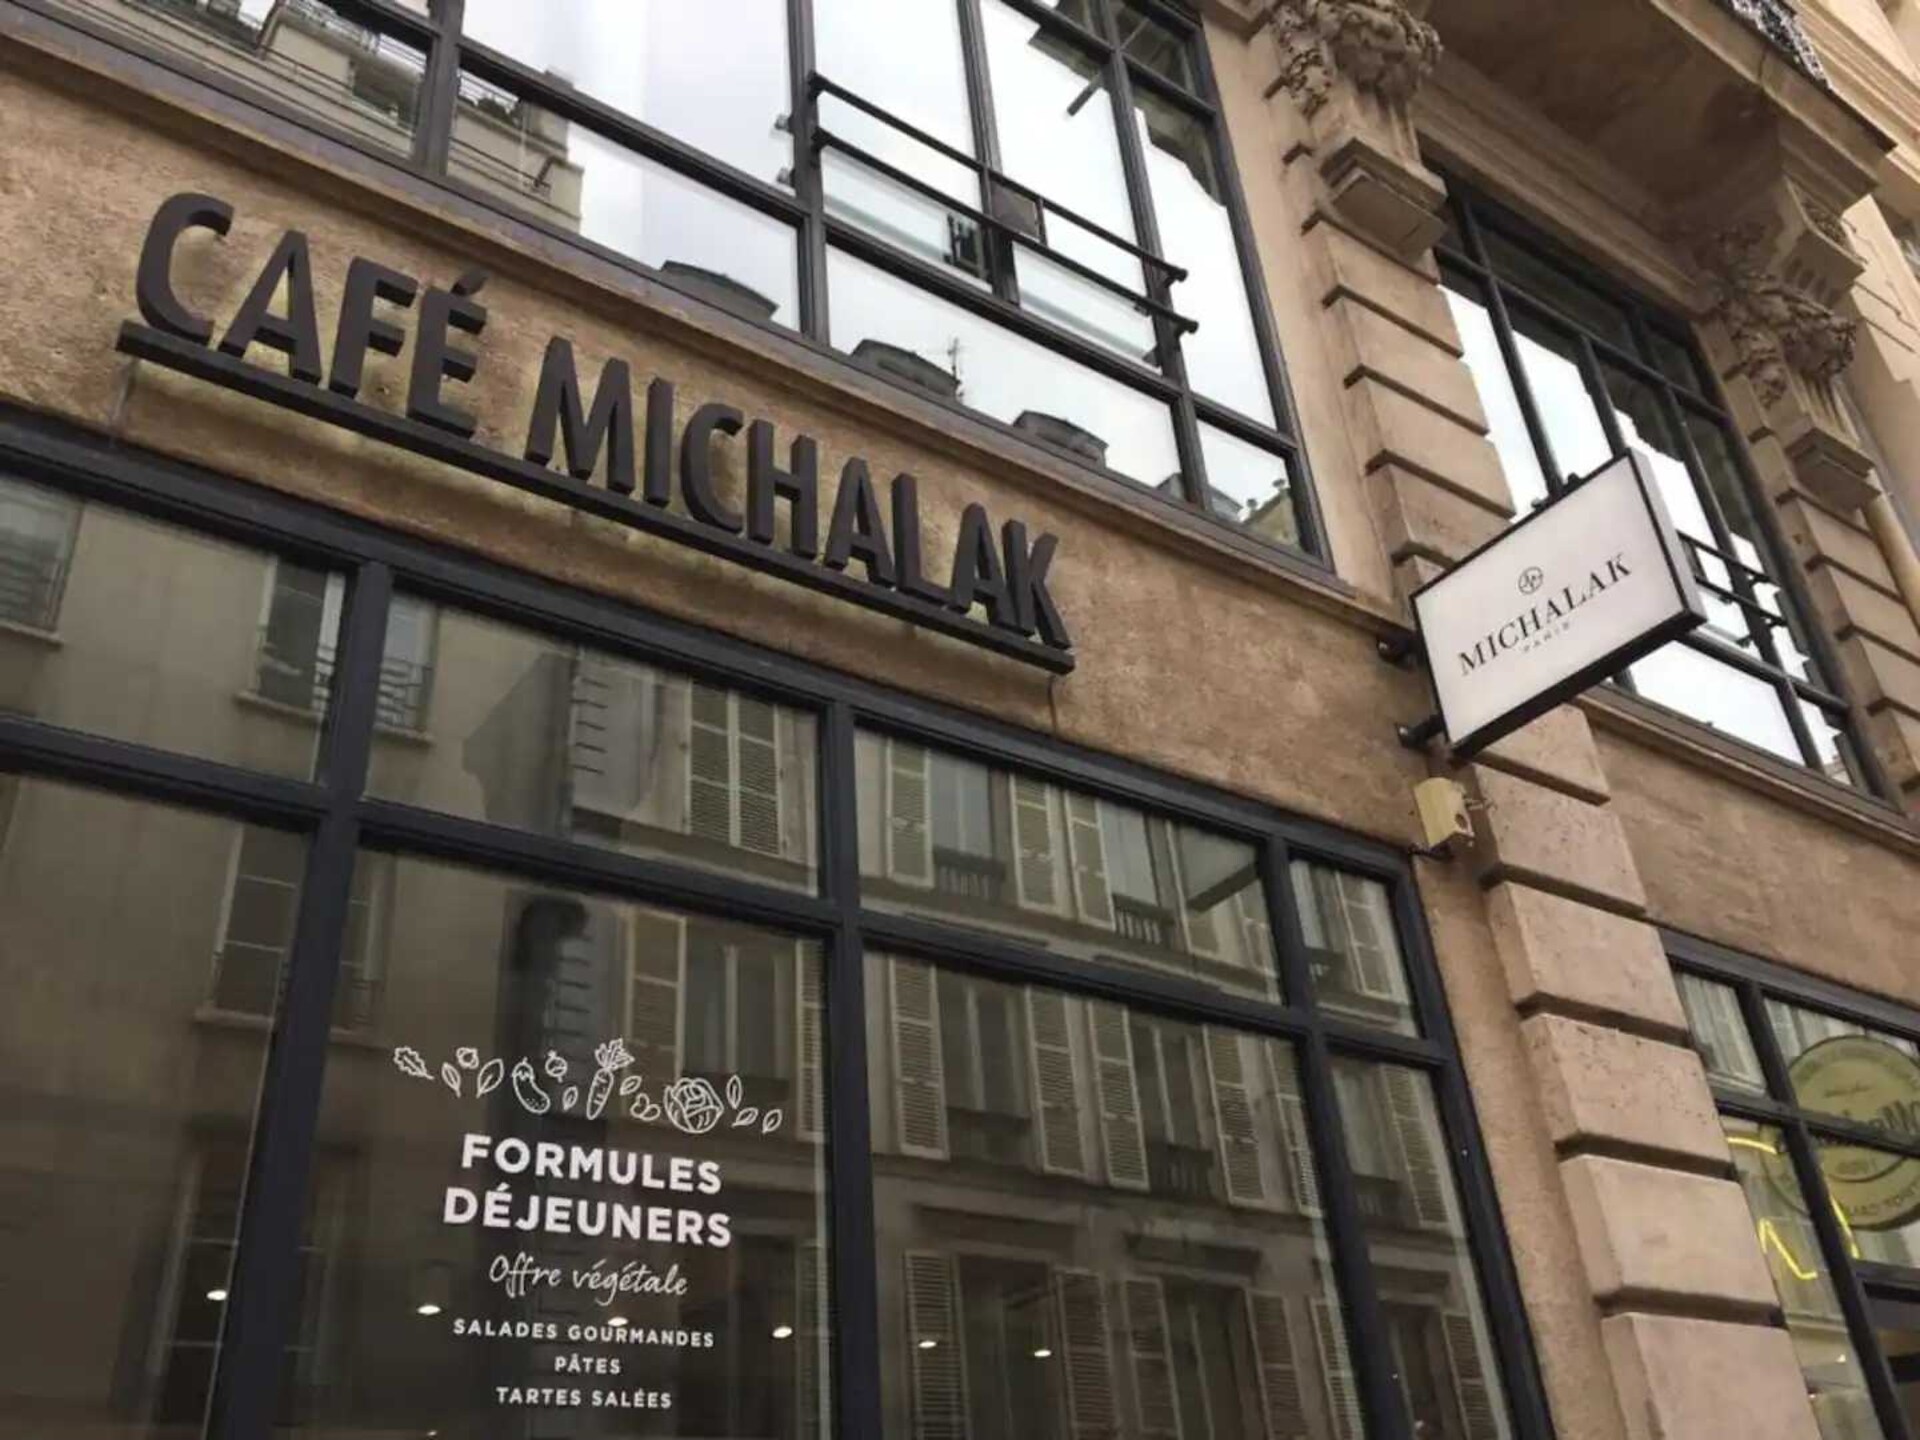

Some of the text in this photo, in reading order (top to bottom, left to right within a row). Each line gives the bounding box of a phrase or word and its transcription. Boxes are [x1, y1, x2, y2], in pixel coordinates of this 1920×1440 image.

[134, 191, 1072, 650] CAFÉ MICHALAK
[1457, 552, 1632, 677] MICHALAK
[460, 1132, 724, 1195] FORMULES
[443, 1182, 733, 1248] DÉJEUNERS
[488, 1251, 689, 1307] Offre végétale
[452, 1318, 715, 1348] SALADES GOURMANDES
[554, 1353, 621, 1375] PÂTES
[496, 1386, 672, 1410] TARTES SALÉES
